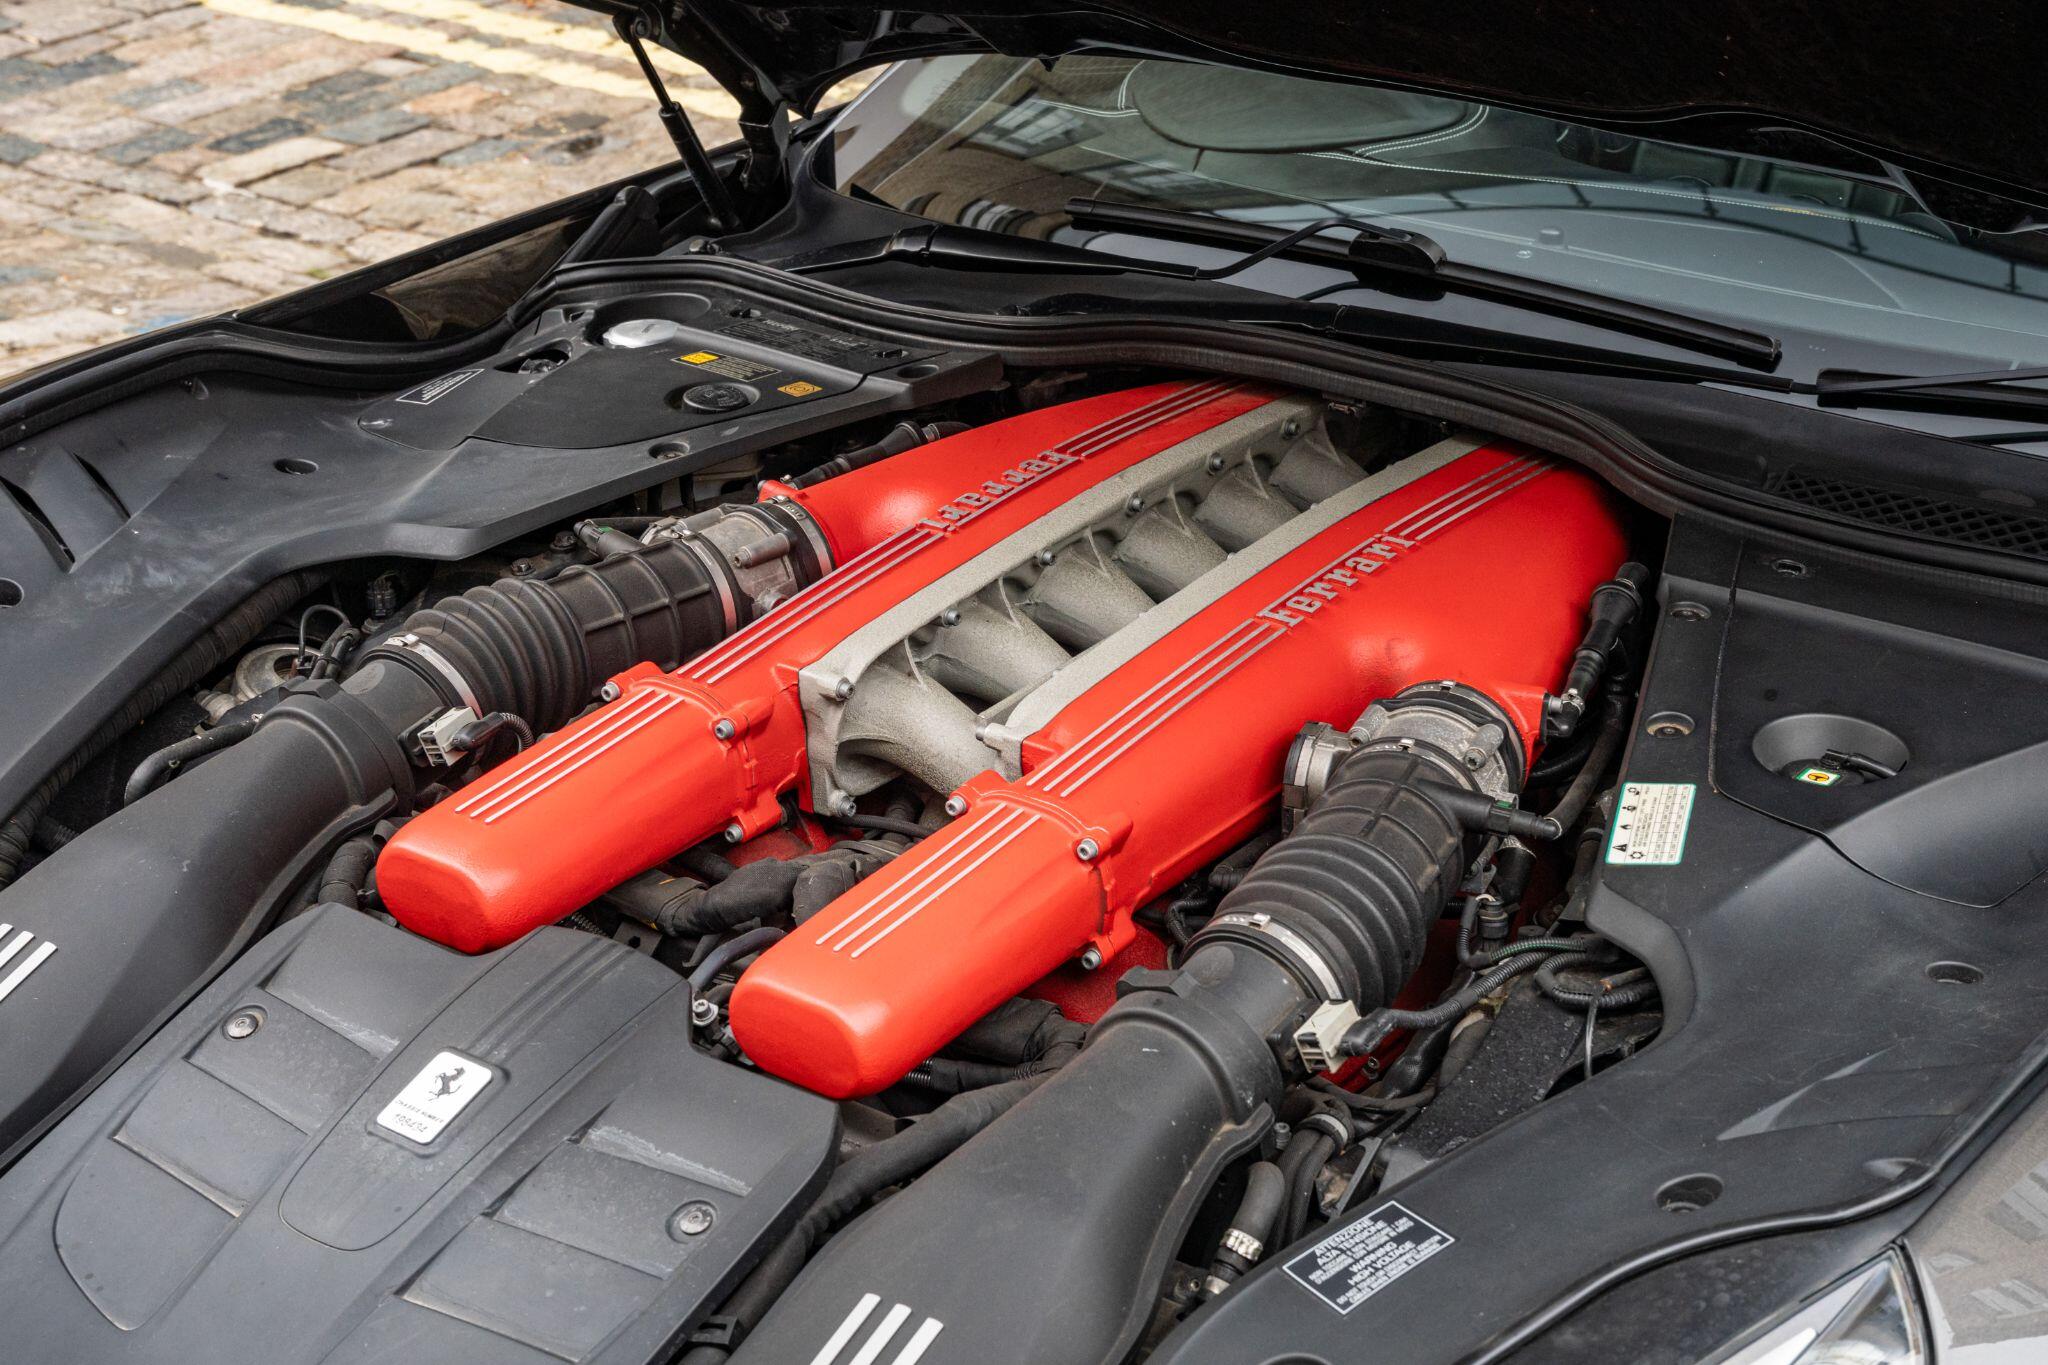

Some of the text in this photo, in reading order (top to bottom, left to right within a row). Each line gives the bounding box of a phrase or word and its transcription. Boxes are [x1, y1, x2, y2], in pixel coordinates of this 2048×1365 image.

[918, 450, 1082, 532] Ferrari
[1255, 533, 1418, 627] Ferrari
[1314, 1217, 1374, 1257] ATTENZIONE
[1316, 1219, 1388, 1266] ALTA TENSIONE
[1349, 1241, 1398, 1273] WARNING
[1348, 1240, 1416, 1286] HIGH VOLTAGE
